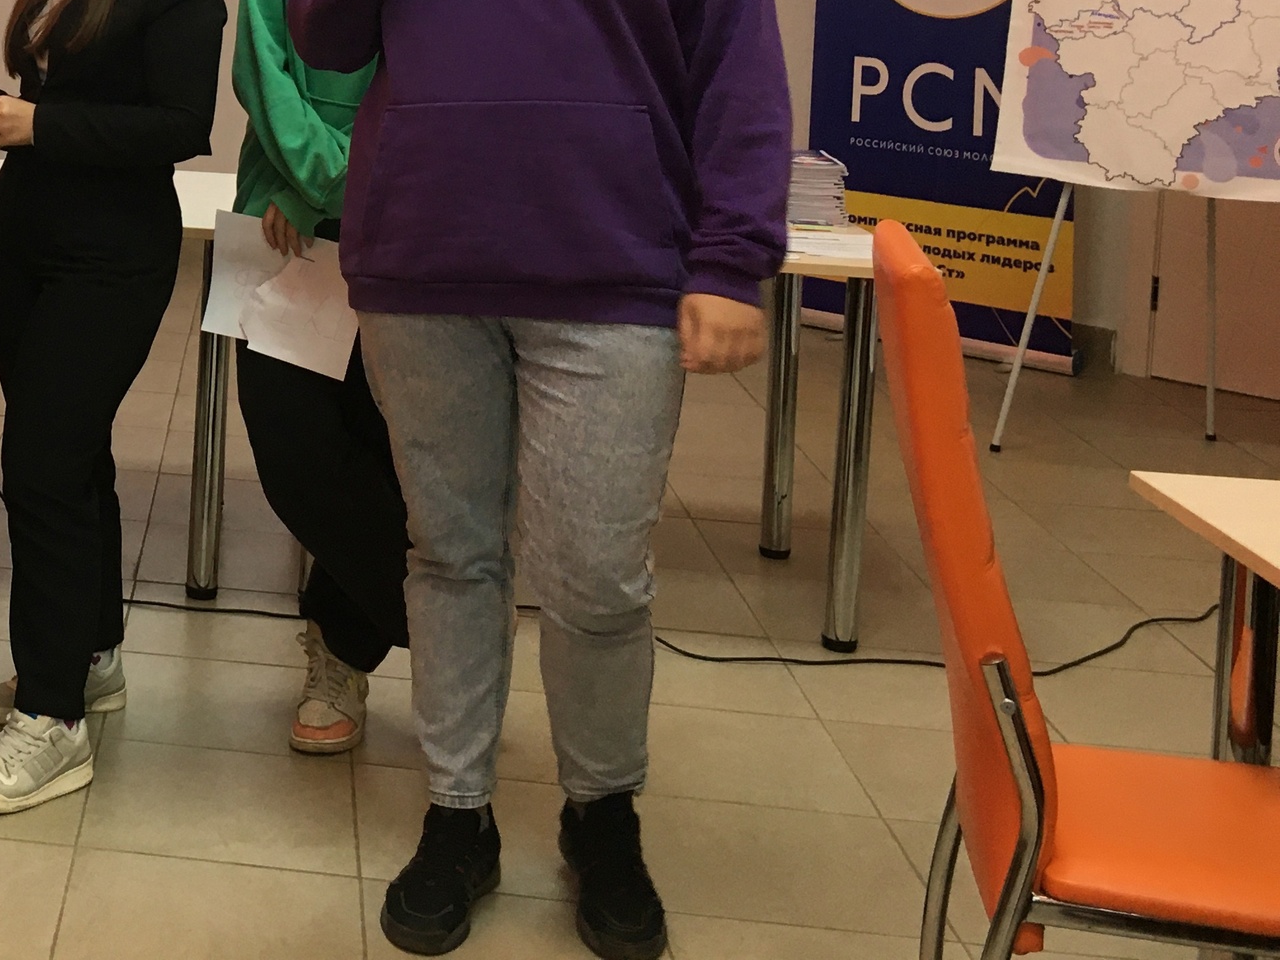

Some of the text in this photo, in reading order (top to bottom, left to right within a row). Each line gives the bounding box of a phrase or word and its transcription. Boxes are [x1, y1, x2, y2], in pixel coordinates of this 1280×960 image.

[849, 136, 924, 153] РОССИЙСКИЙ
[927, 146, 959, 159] СОЮЗ
[946, 230, 1040, 251] программа
